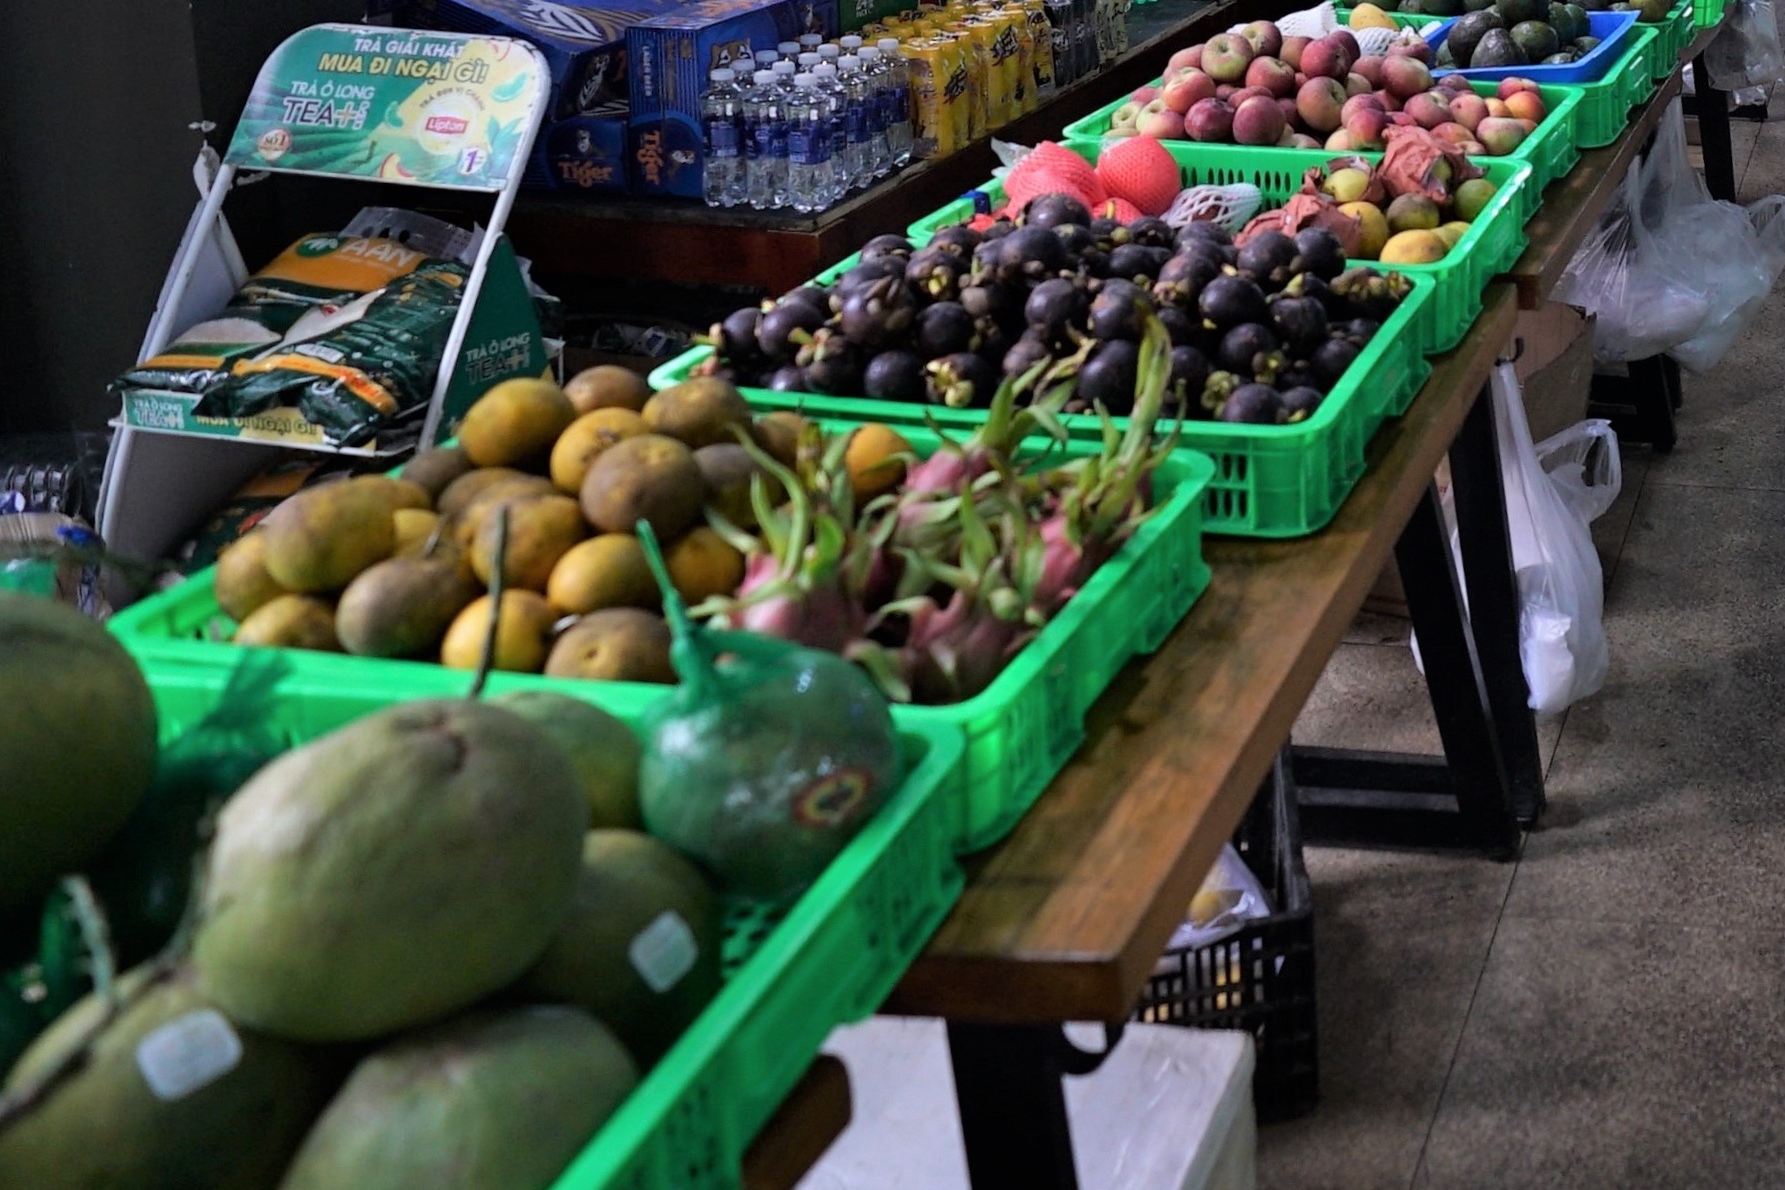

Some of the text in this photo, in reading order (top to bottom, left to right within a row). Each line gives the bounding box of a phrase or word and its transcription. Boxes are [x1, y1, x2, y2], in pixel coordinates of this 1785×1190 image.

[354, 36, 465, 59] TRÀ GIẢI KHÁT
[318, 53, 490, 85] MUA ĐI NGẠI GÌ!
[290, 77, 317, 97] TRÀ
[335, 84, 376, 100] LONG
[426, 119, 468, 135] Lipton
[556, 157, 614, 189] Tiger
[636, 130, 664, 187] Tiger
[465, 346, 488, 363] TRÀ
[500, 332, 531, 351] LONG
